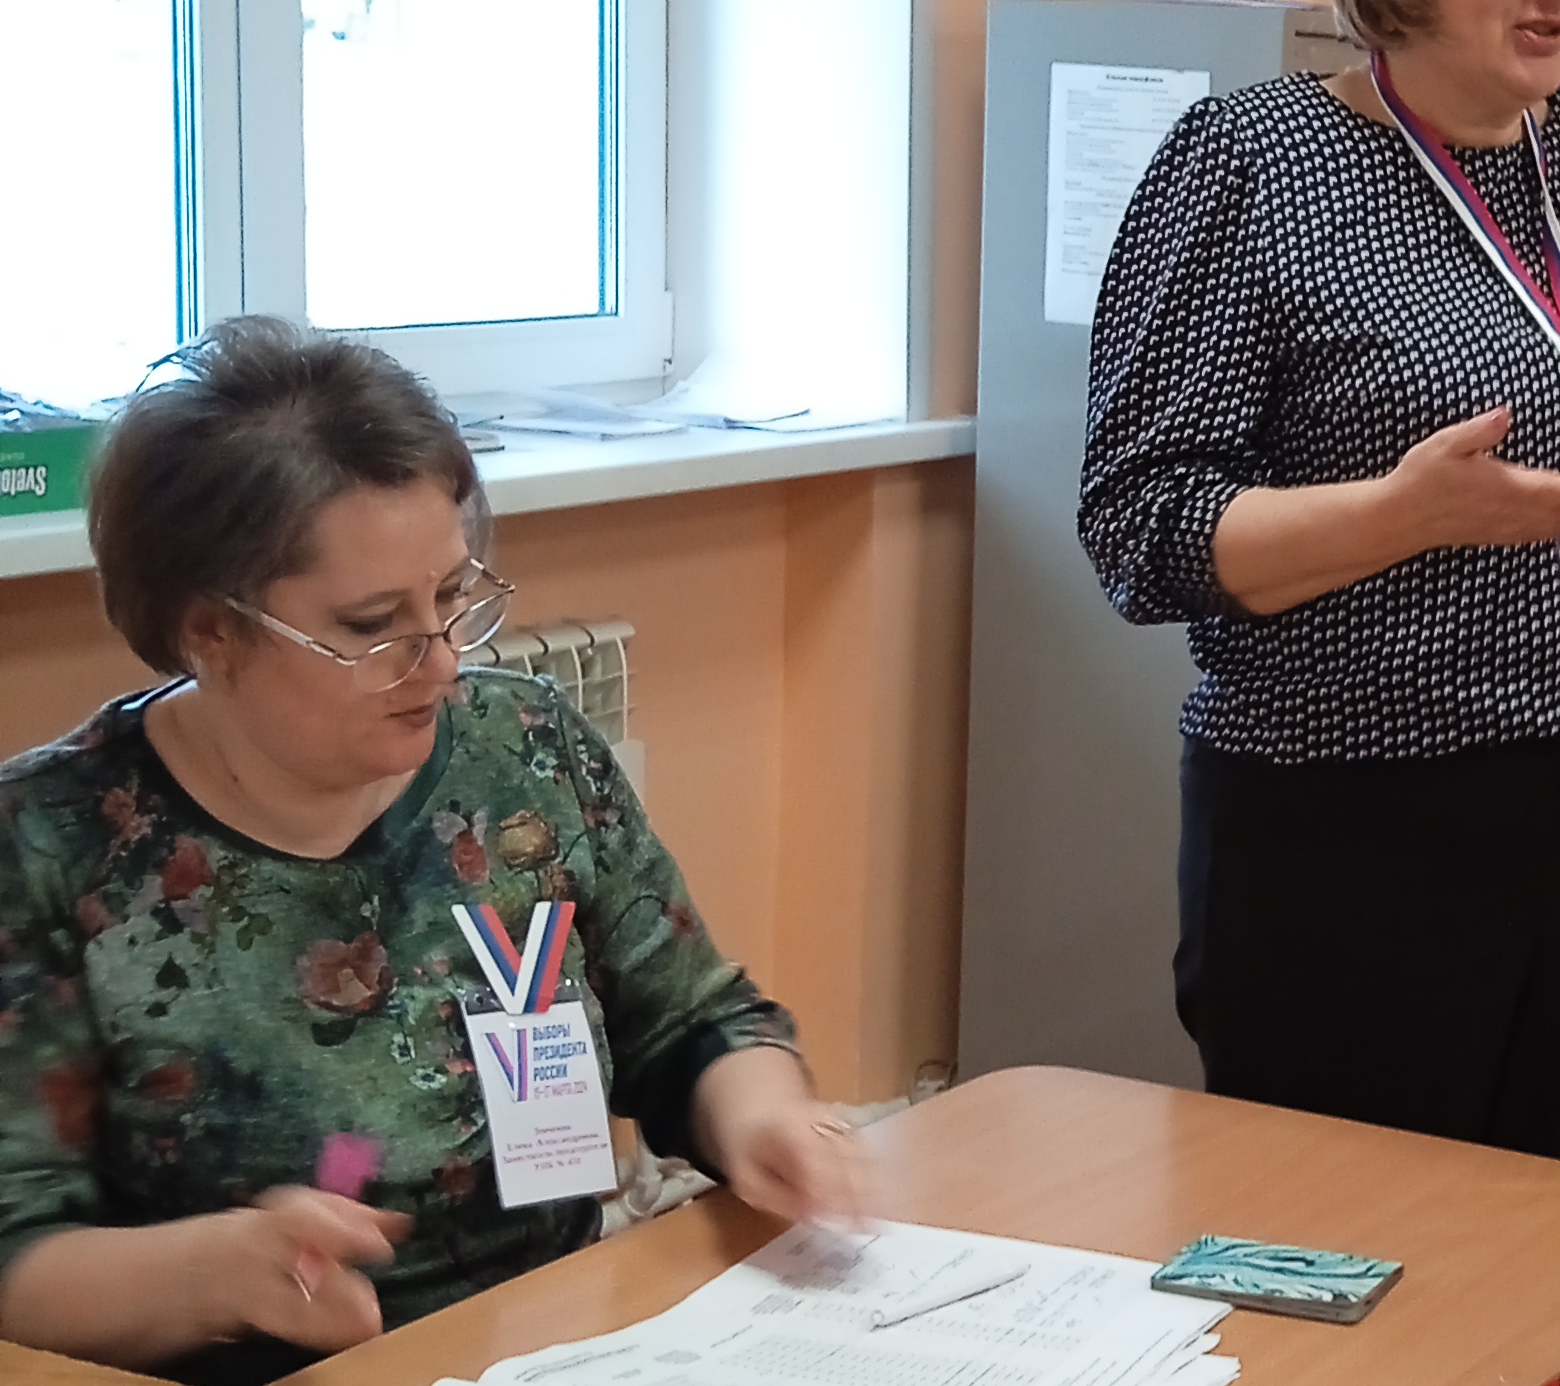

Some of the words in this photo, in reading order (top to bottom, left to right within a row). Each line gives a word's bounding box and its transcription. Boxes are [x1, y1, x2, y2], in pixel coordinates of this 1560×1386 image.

[0, 466, 47, 496] Sveto
[533, 1023, 571, 1041] ВЫБОРЫ
[533, 1041, 588, 1061] ПРЕЗИДЕНТА
[533, 1064, 568, 1081] РОССИИ
